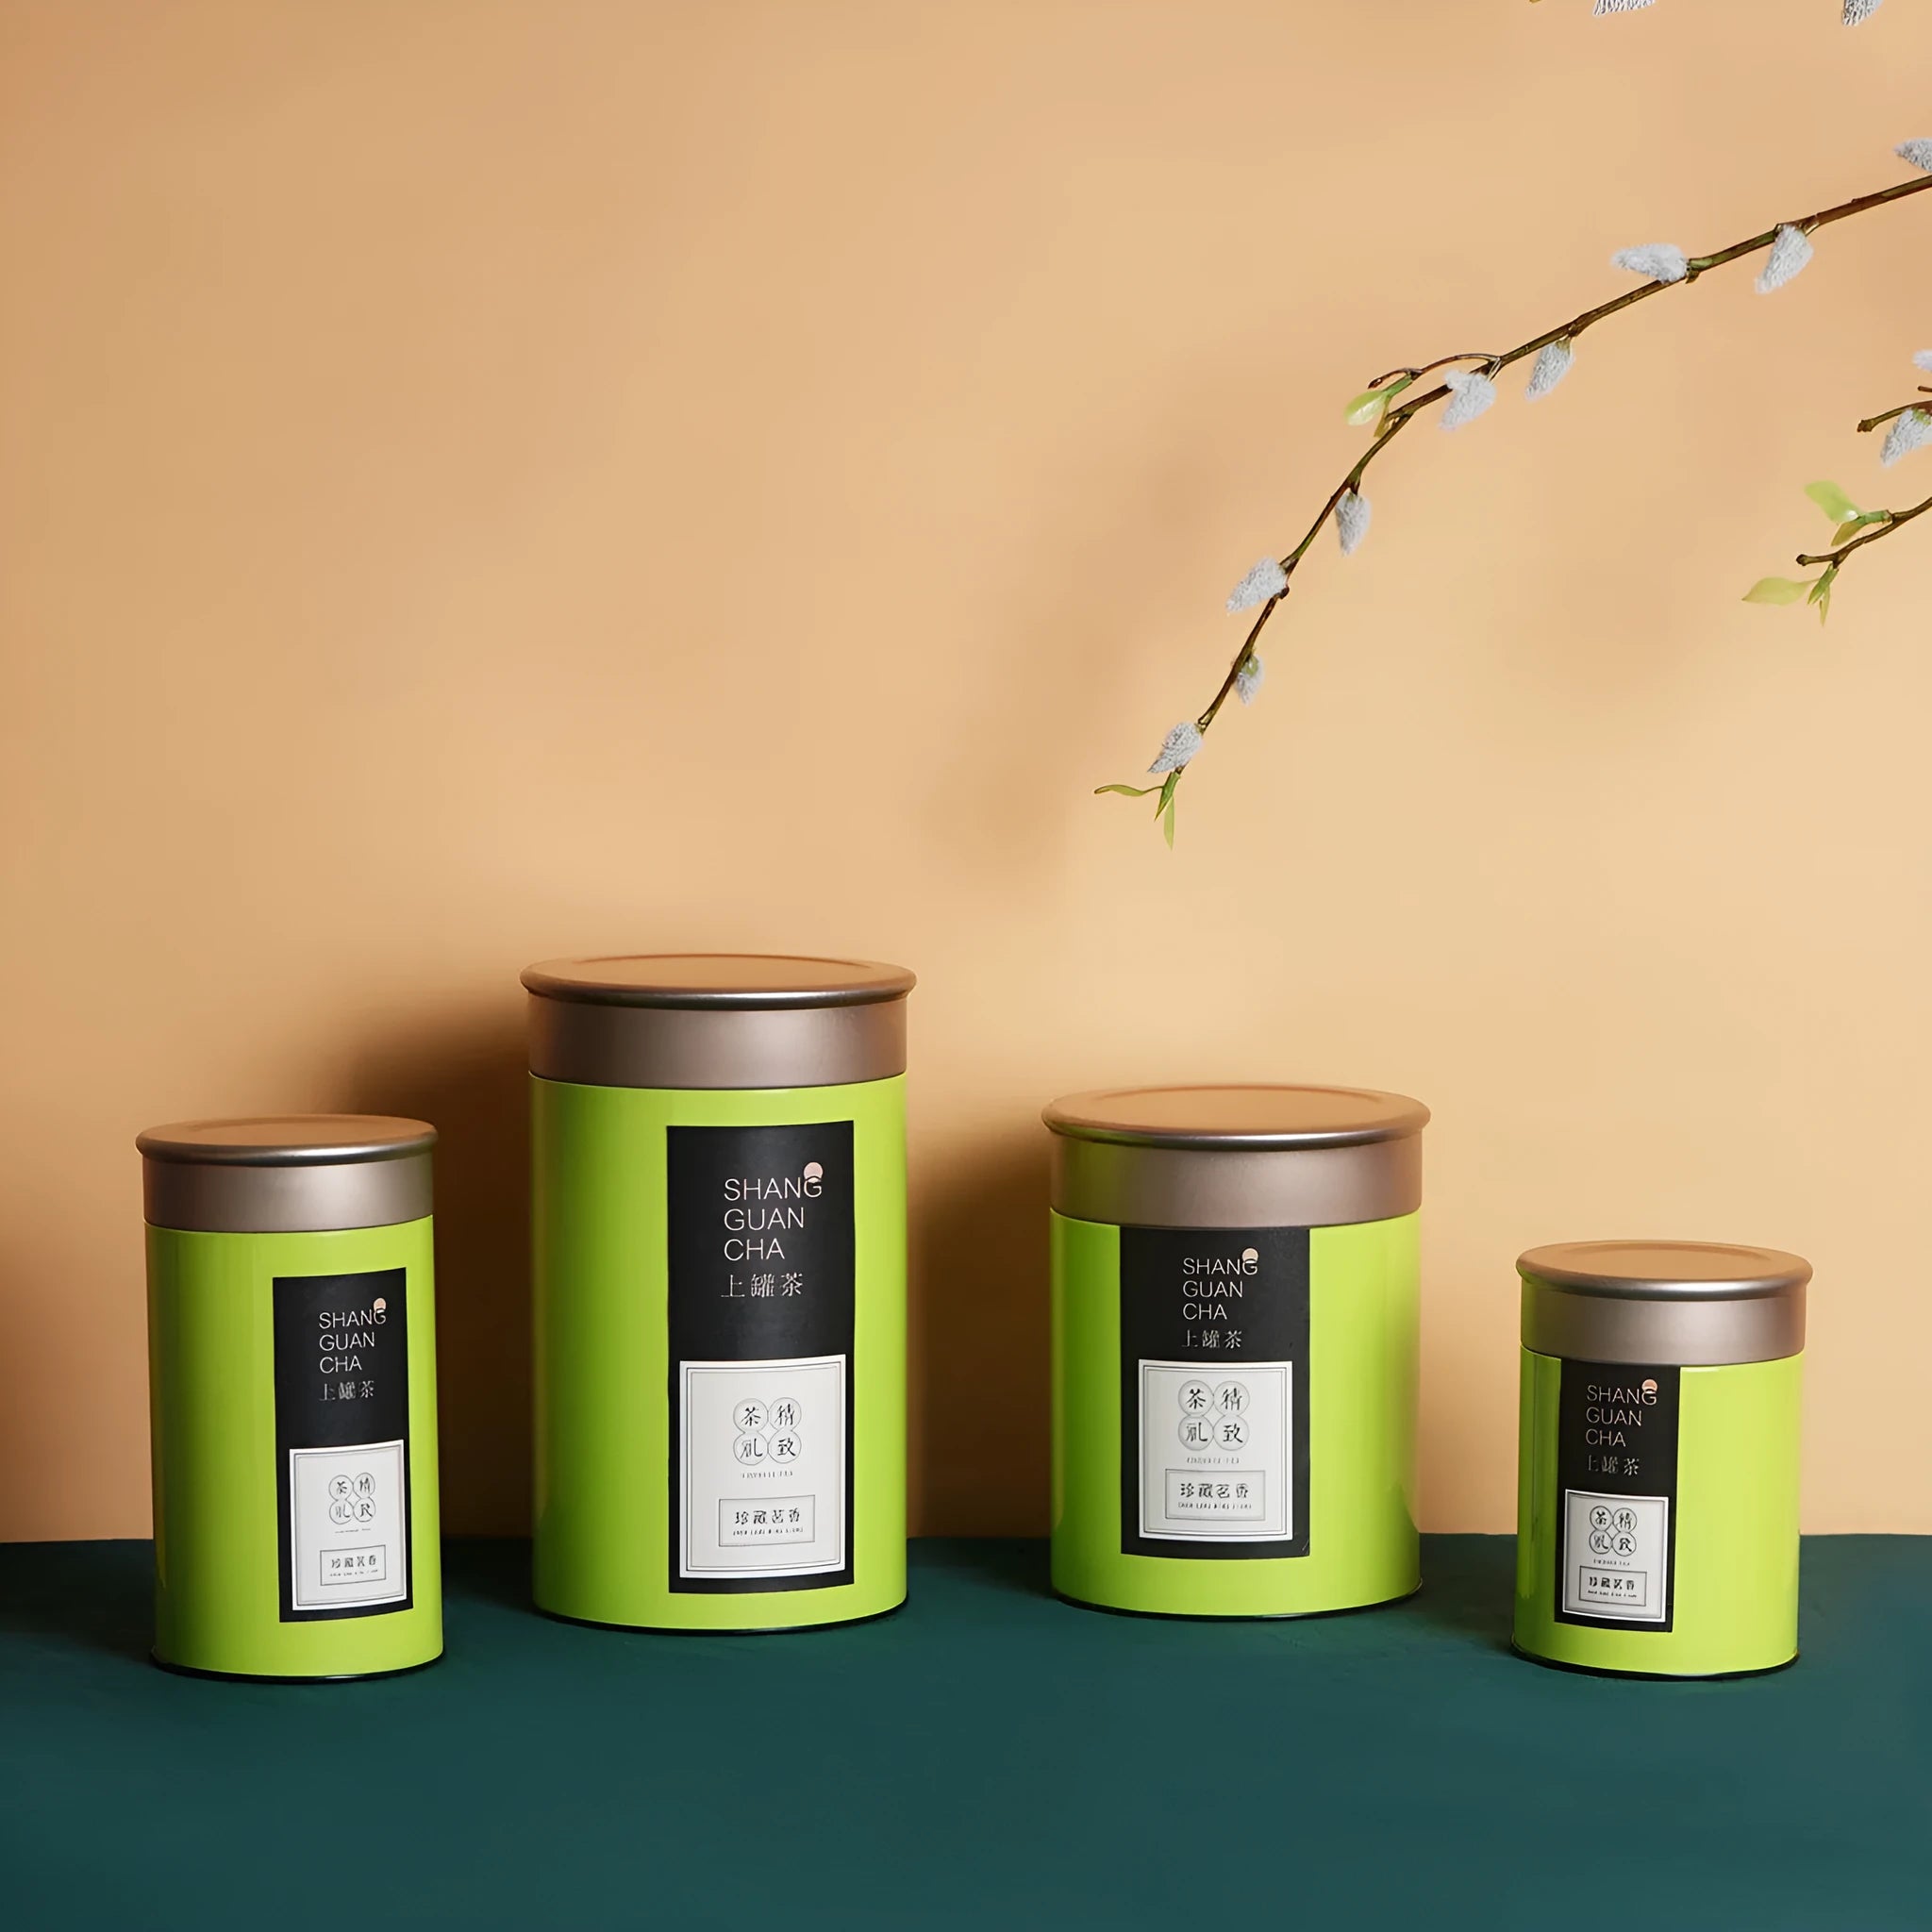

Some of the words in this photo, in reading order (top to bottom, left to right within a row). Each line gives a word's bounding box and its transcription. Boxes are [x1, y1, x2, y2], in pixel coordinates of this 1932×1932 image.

[724, 1176, 823, 1201] SHANG
[724, 1207, 805, 1231] GUAN
[724, 1238, 786, 1261] CHA
[1182, 1257, 1258, 1275] SHANG
[1182, 1280, 1243, 1298] GUAN
[319, 1307, 387, 1329] SHANG
[1182, 1303, 1227, 1321] CHA
[319, 1331, 375, 1352] GUAN
[319, 1355, 362, 1374] CHA
[1587, 1384, 1657, 1406] SHANG
[1586, 1407, 1642, 1426] GUAN
[1585, 1428, 1626, 1447] CHA
